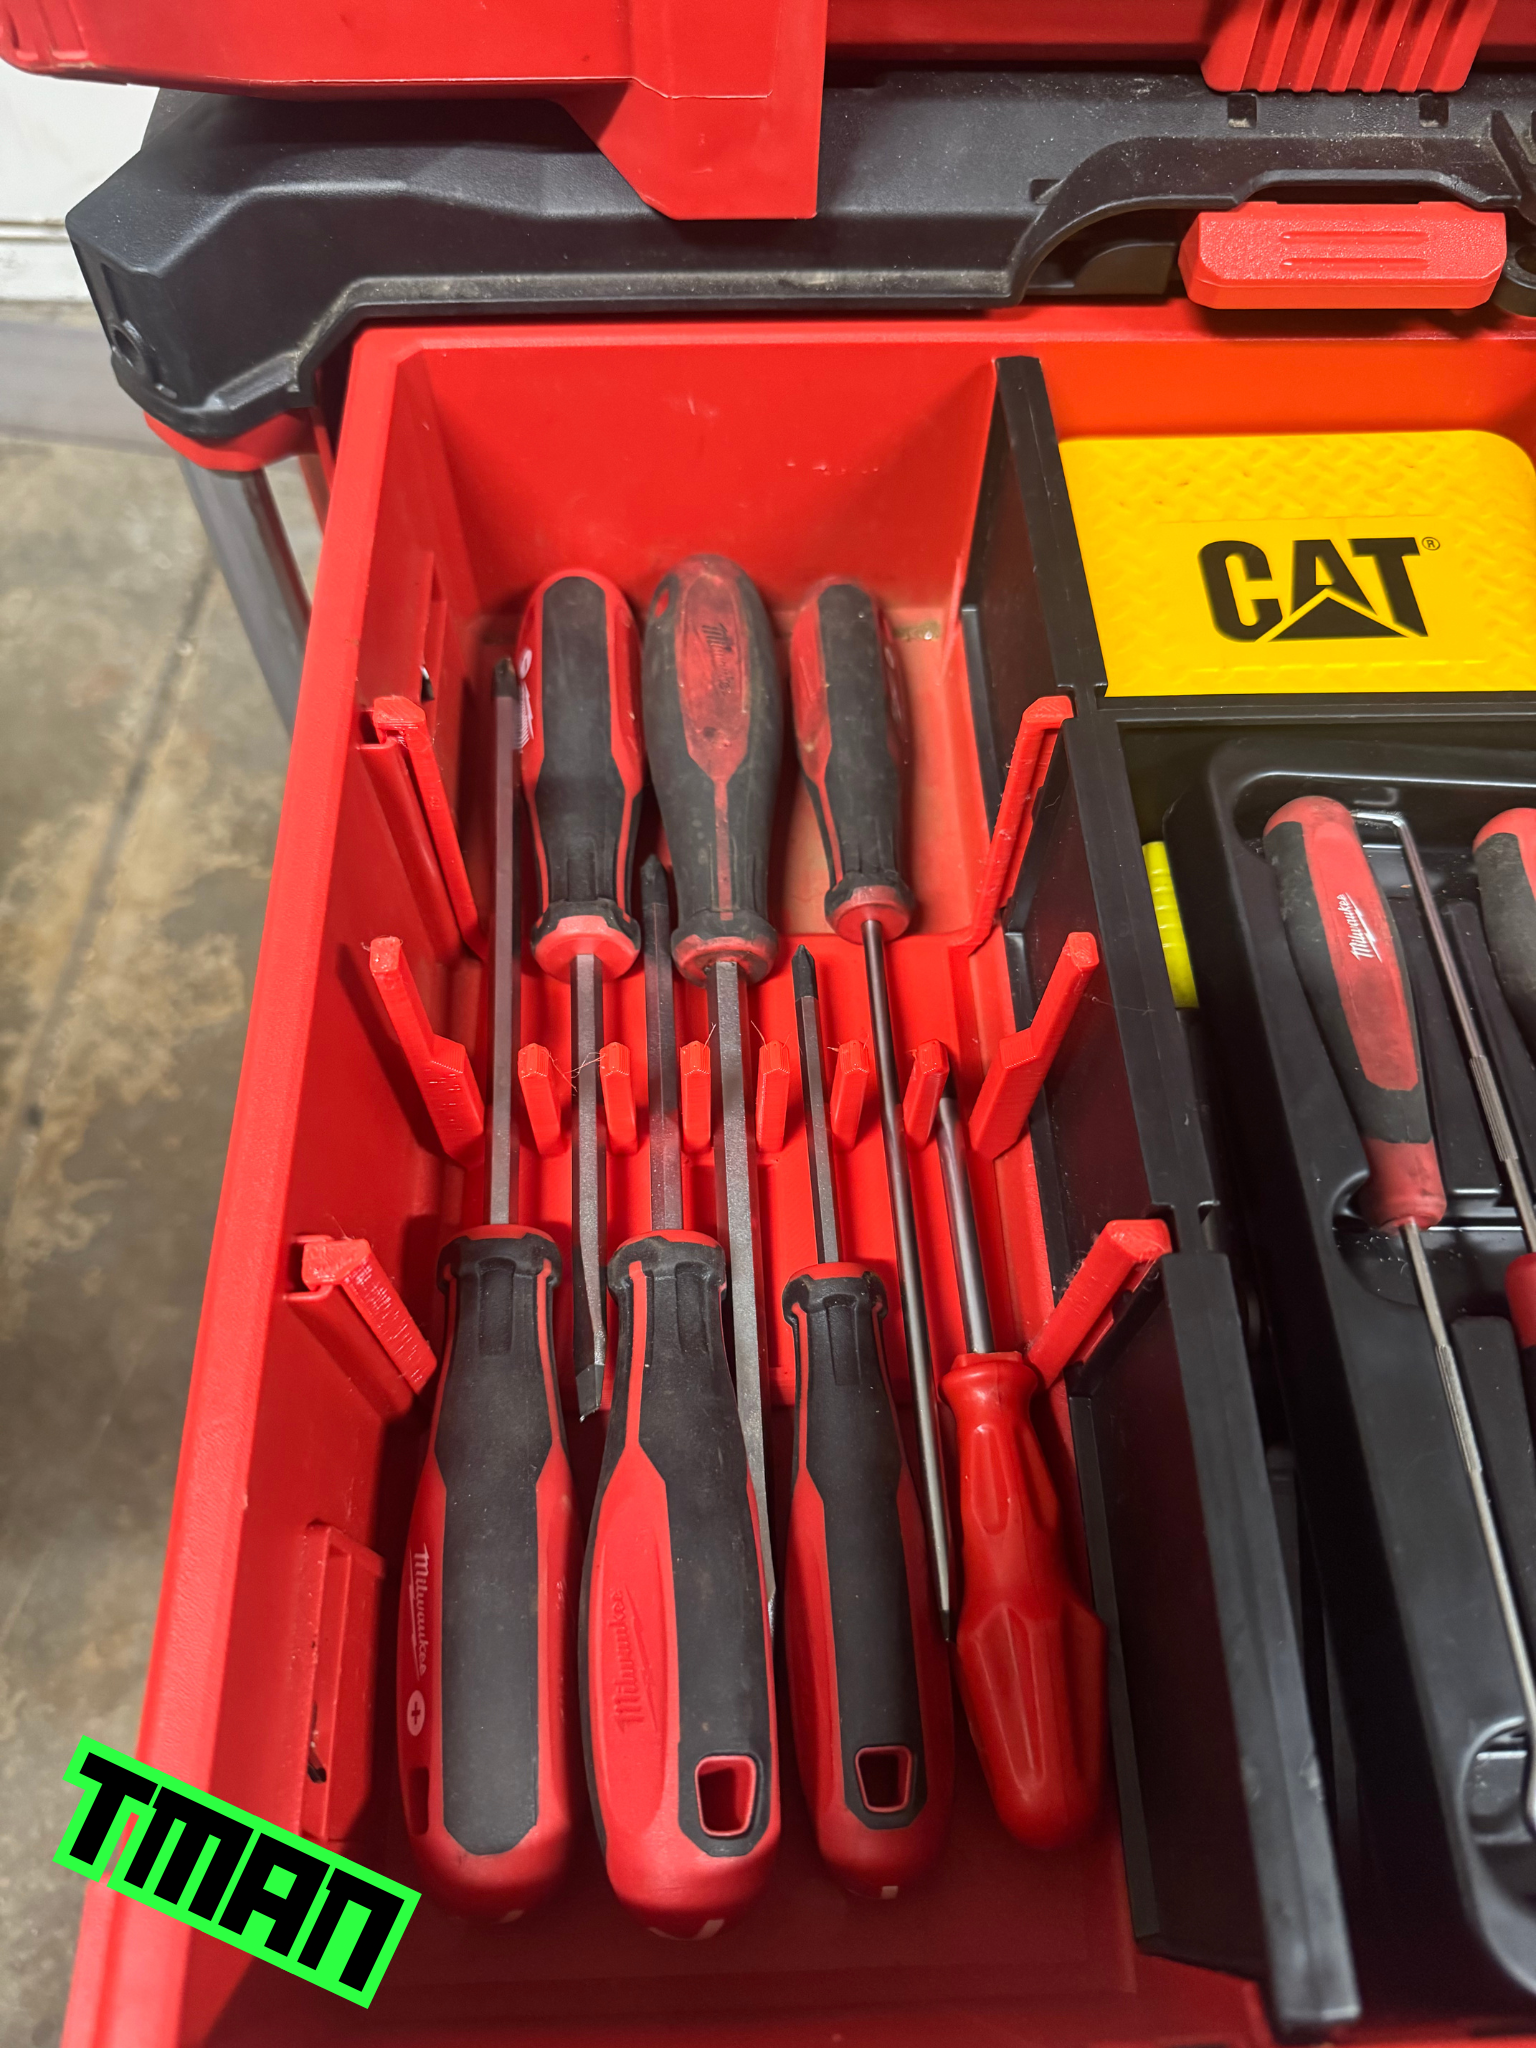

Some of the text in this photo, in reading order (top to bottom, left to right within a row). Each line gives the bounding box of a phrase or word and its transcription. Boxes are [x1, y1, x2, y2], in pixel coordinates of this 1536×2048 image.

[1336, 892, 1376, 962] Milwaukee
[413, 1542, 430, 1678] Milwaukee
[608, 1585, 647, 1733] Milwaukee
